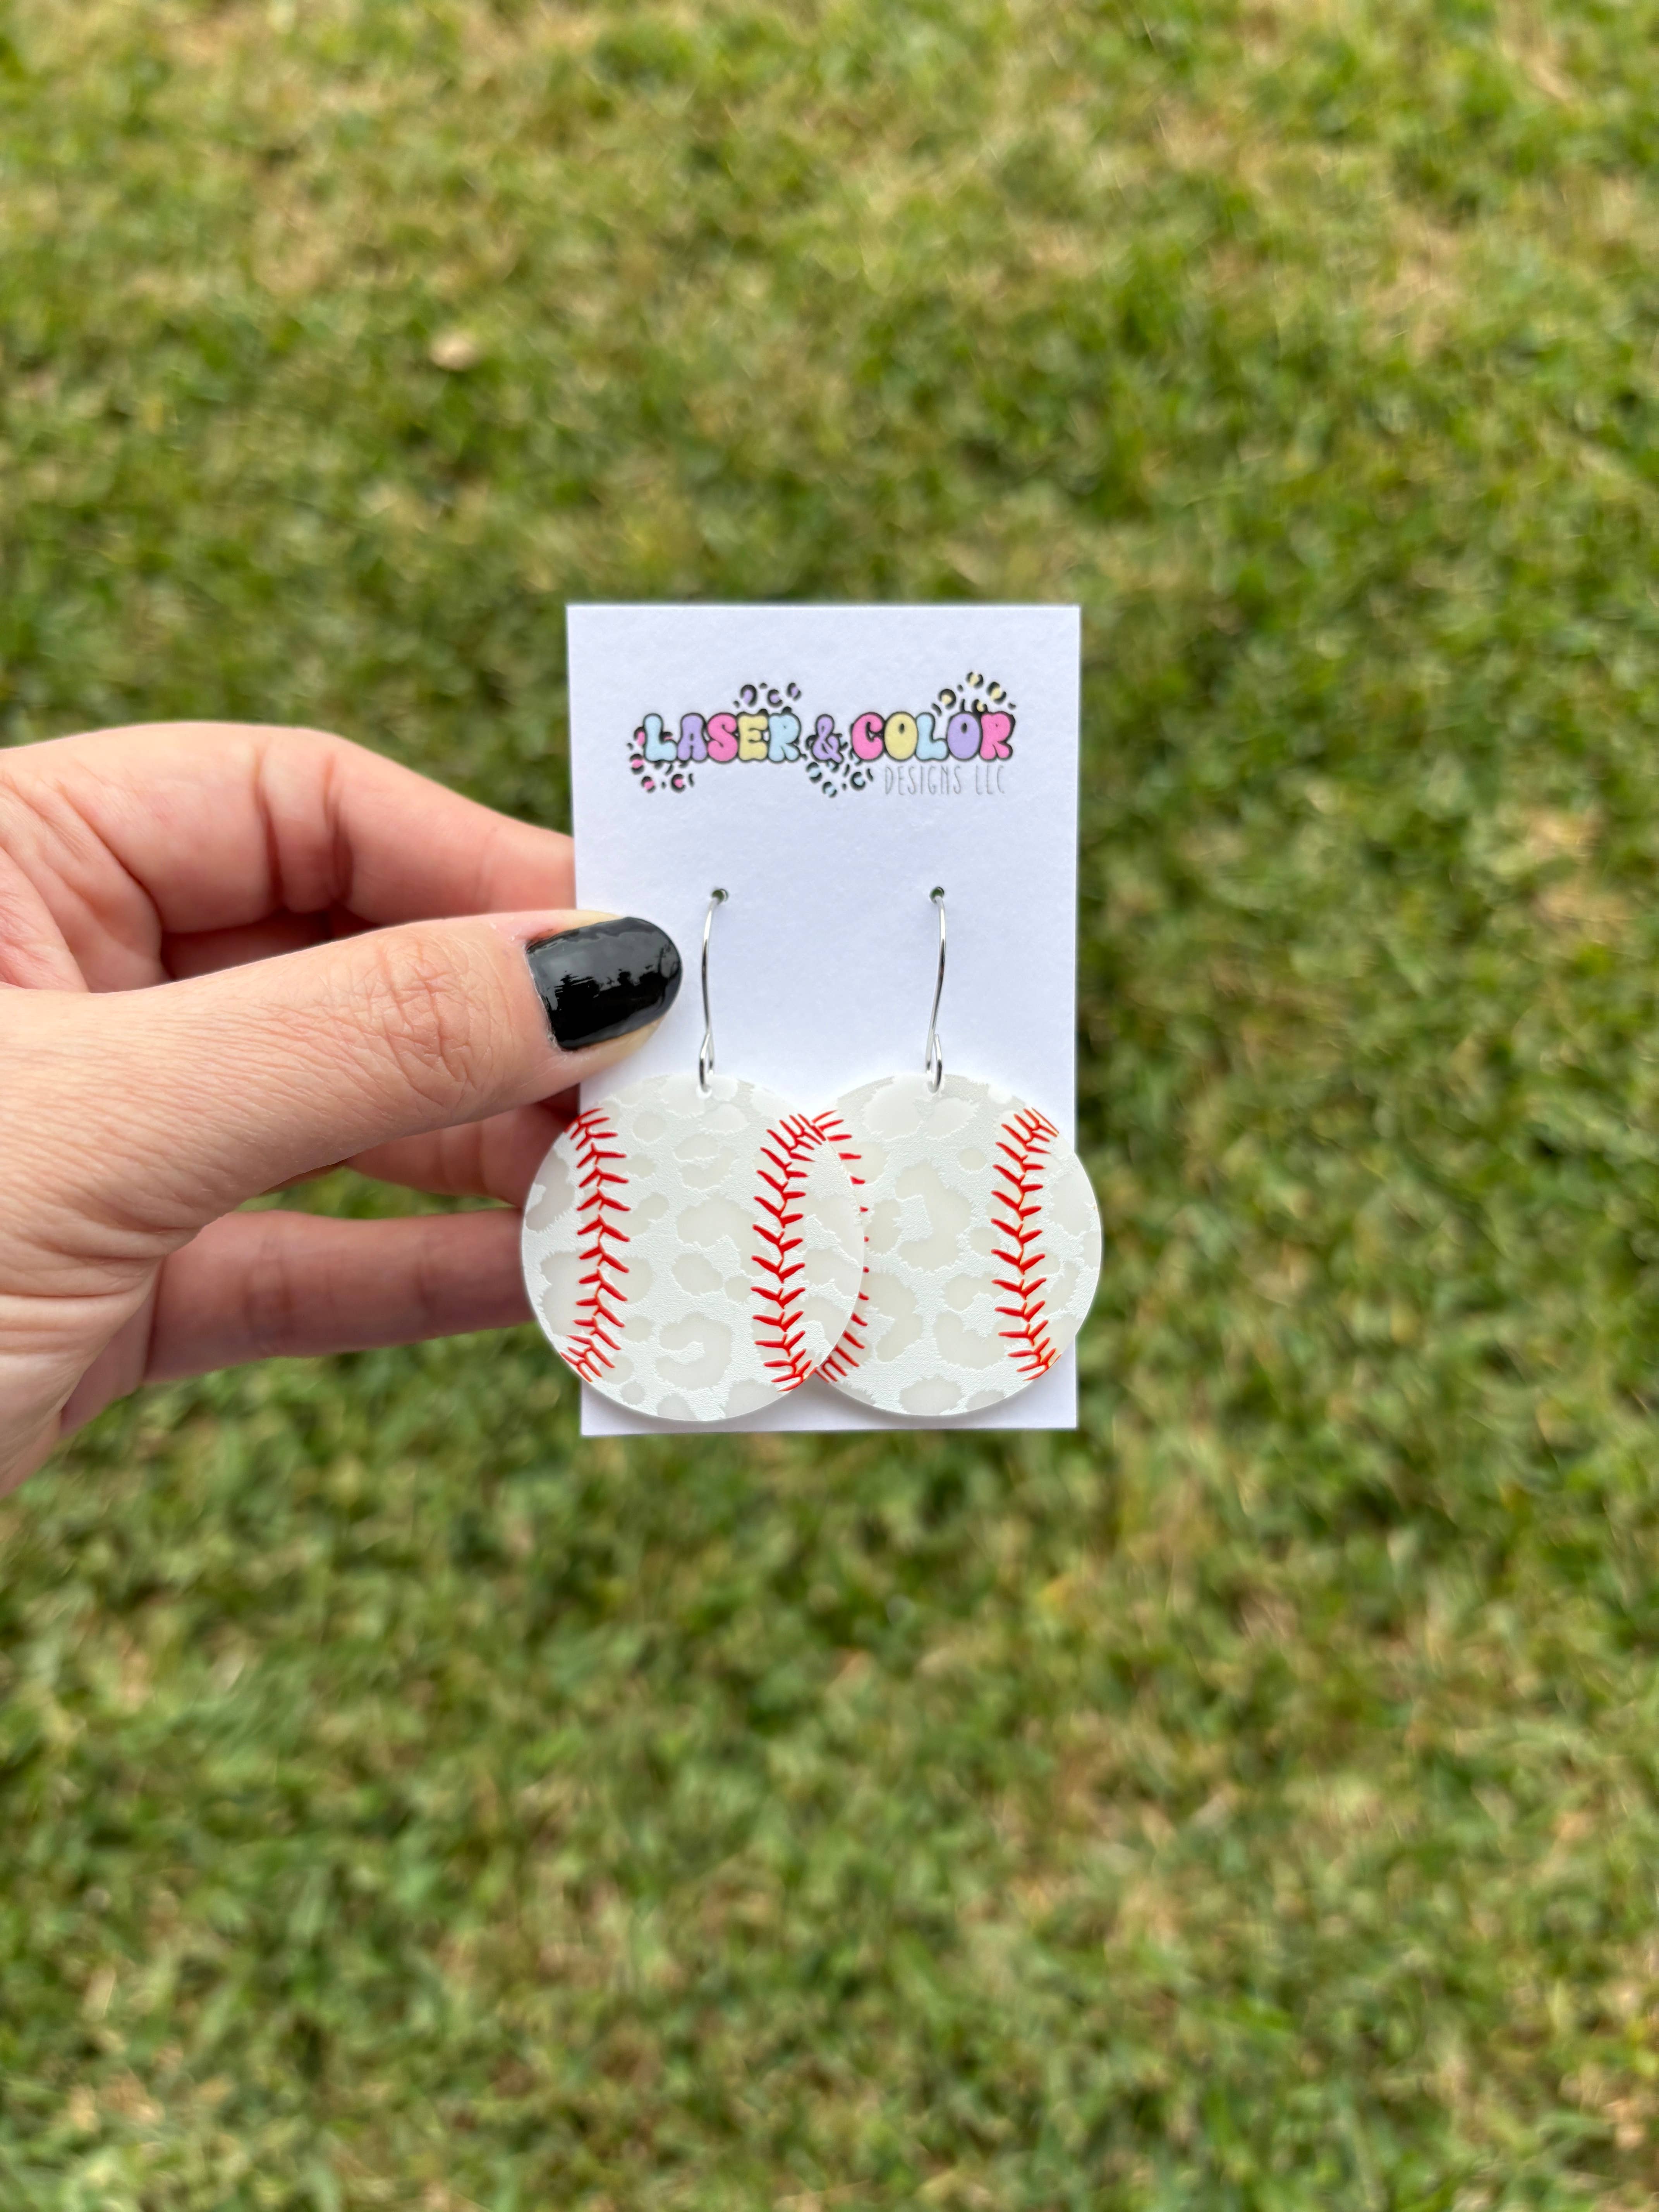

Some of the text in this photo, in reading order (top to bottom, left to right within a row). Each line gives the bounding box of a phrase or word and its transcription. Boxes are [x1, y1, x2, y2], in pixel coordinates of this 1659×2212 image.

[642, 711, 1013, 763] LASER & COLOR
[884, 764, 1006, 796] DESIGNS LLC
